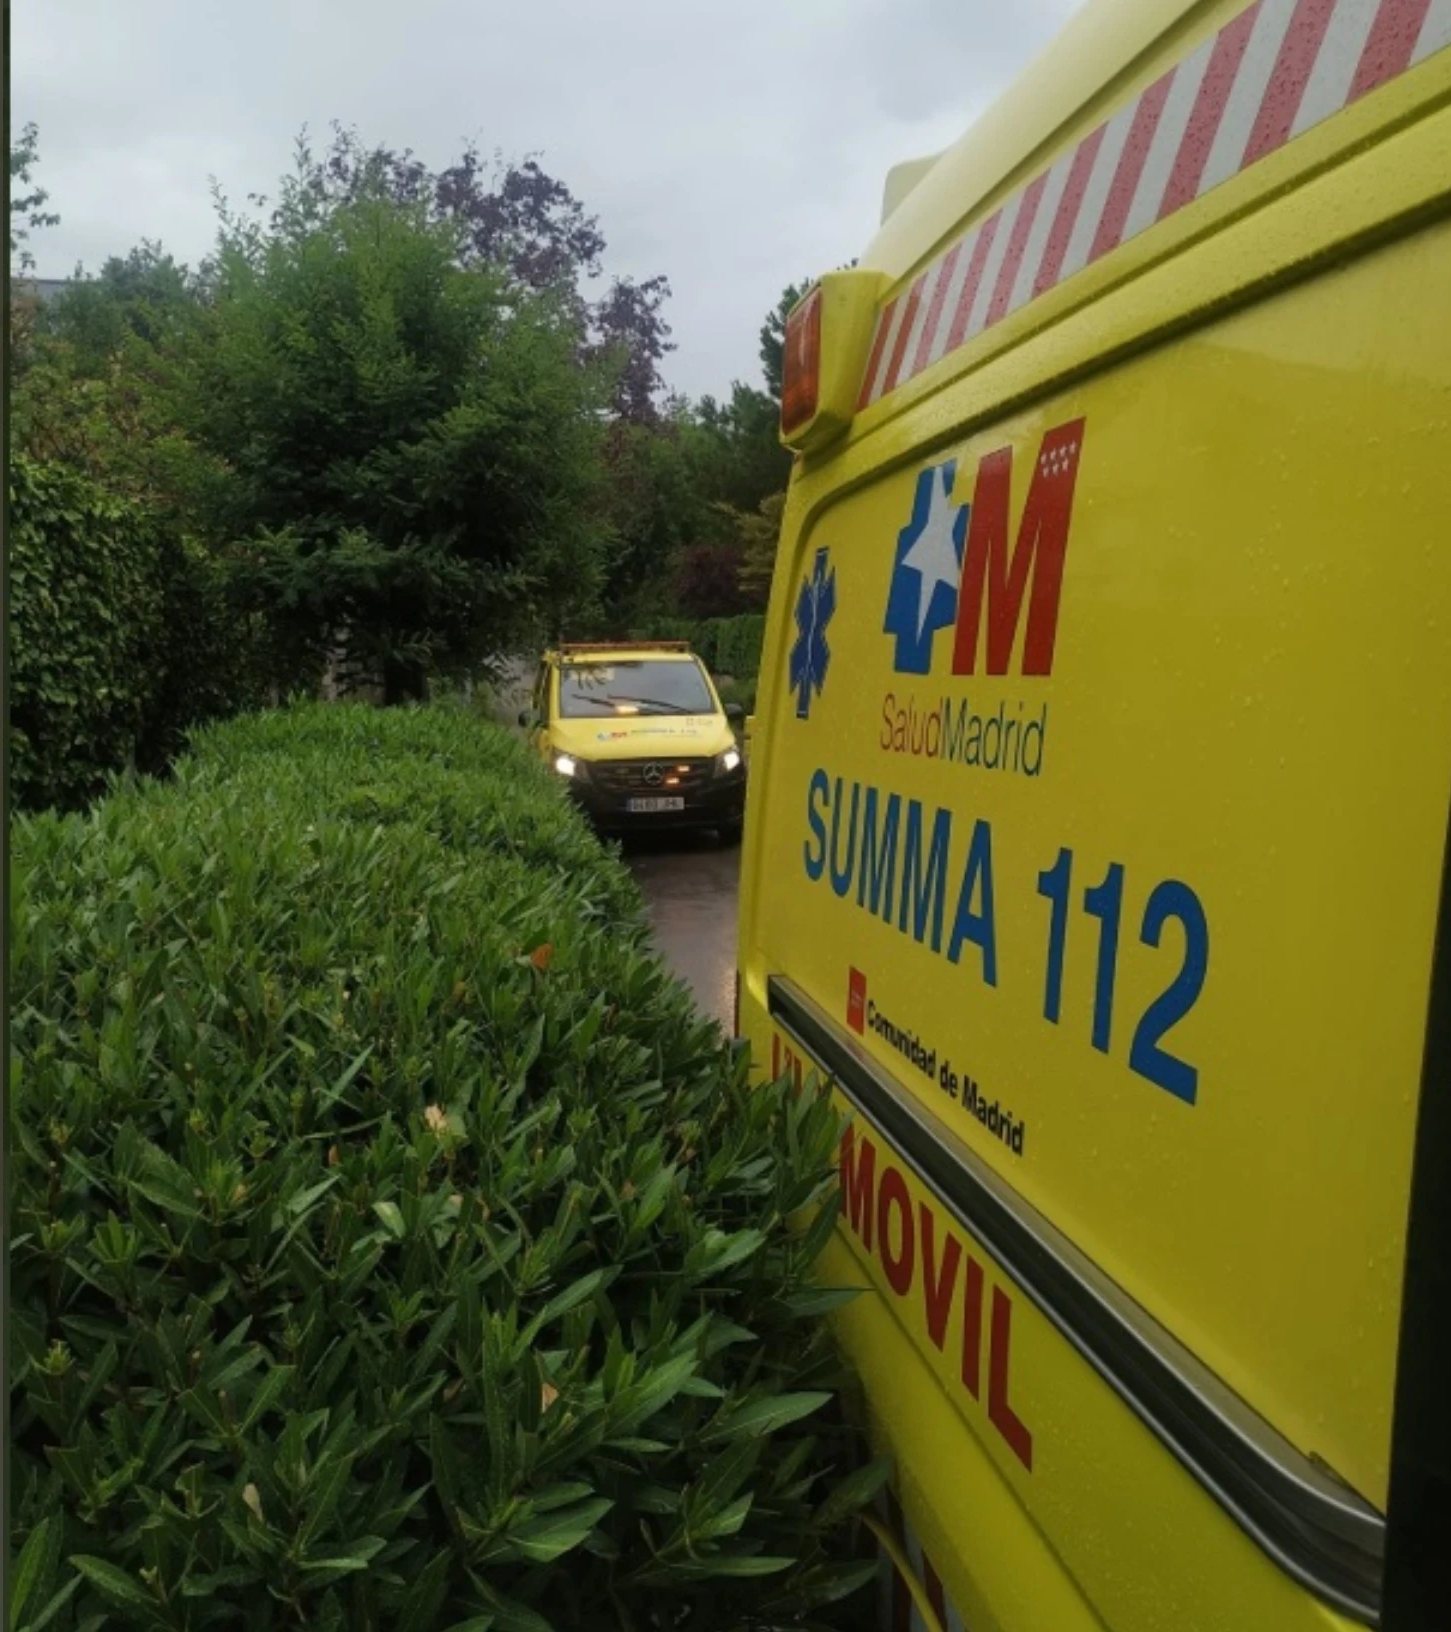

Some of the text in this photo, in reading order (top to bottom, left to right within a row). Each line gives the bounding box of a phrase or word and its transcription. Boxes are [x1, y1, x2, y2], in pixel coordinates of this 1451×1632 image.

[951, 416, 1086, 676] M
[880, 693, 1047, 776] SaludMadrid
[803, 768, 1210, 1107] SUMMA 112
[867, 999, 936, 1080] Comunidad
[940, 1060, 958, 1099] de
[961, 1074, 1025, 1157] Madrid
[839, 1122, 1032, 1475] MOVIL
